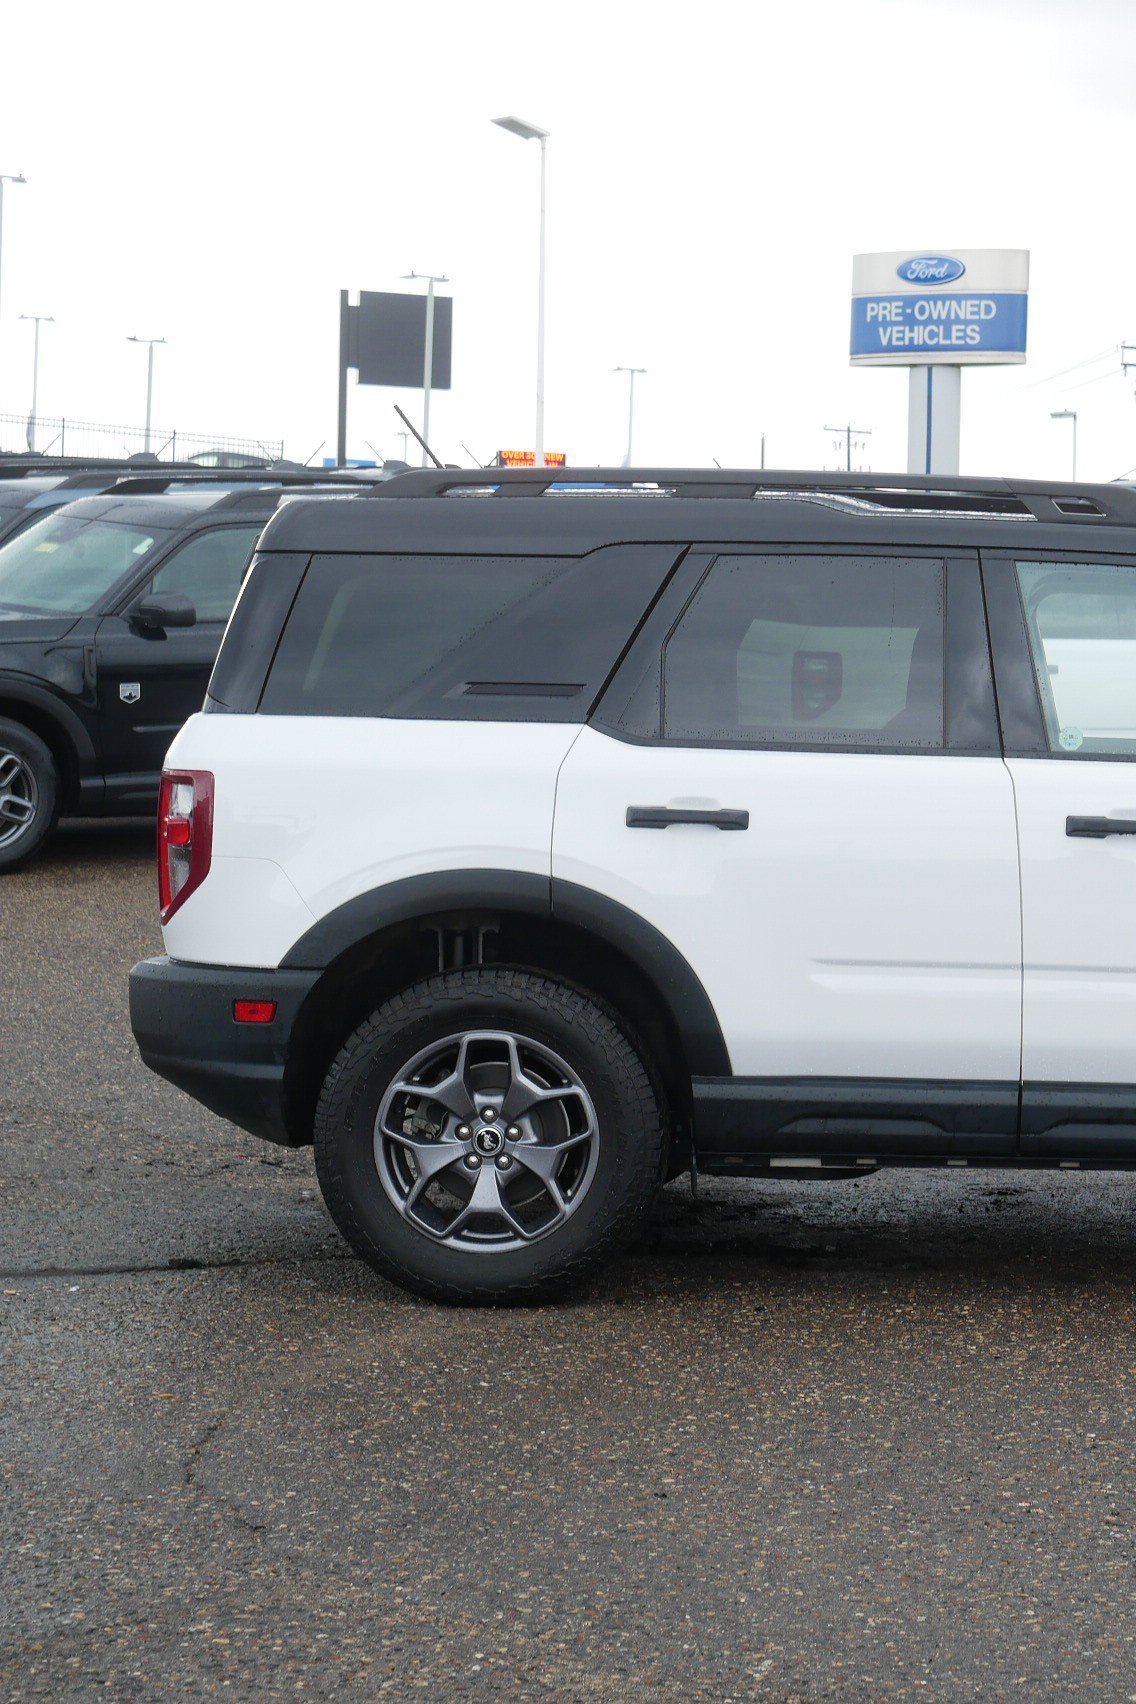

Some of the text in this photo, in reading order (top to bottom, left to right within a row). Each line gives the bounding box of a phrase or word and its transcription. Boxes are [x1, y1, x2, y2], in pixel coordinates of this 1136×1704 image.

[907, 258, 949, 280] Ford
[866, 300, 997, 323] PRE-OWNED
[878, 325, 981, 347] VEHICLES
[502, 450, 525, 459] OVER
[544, 453, 564, 461] NEW
